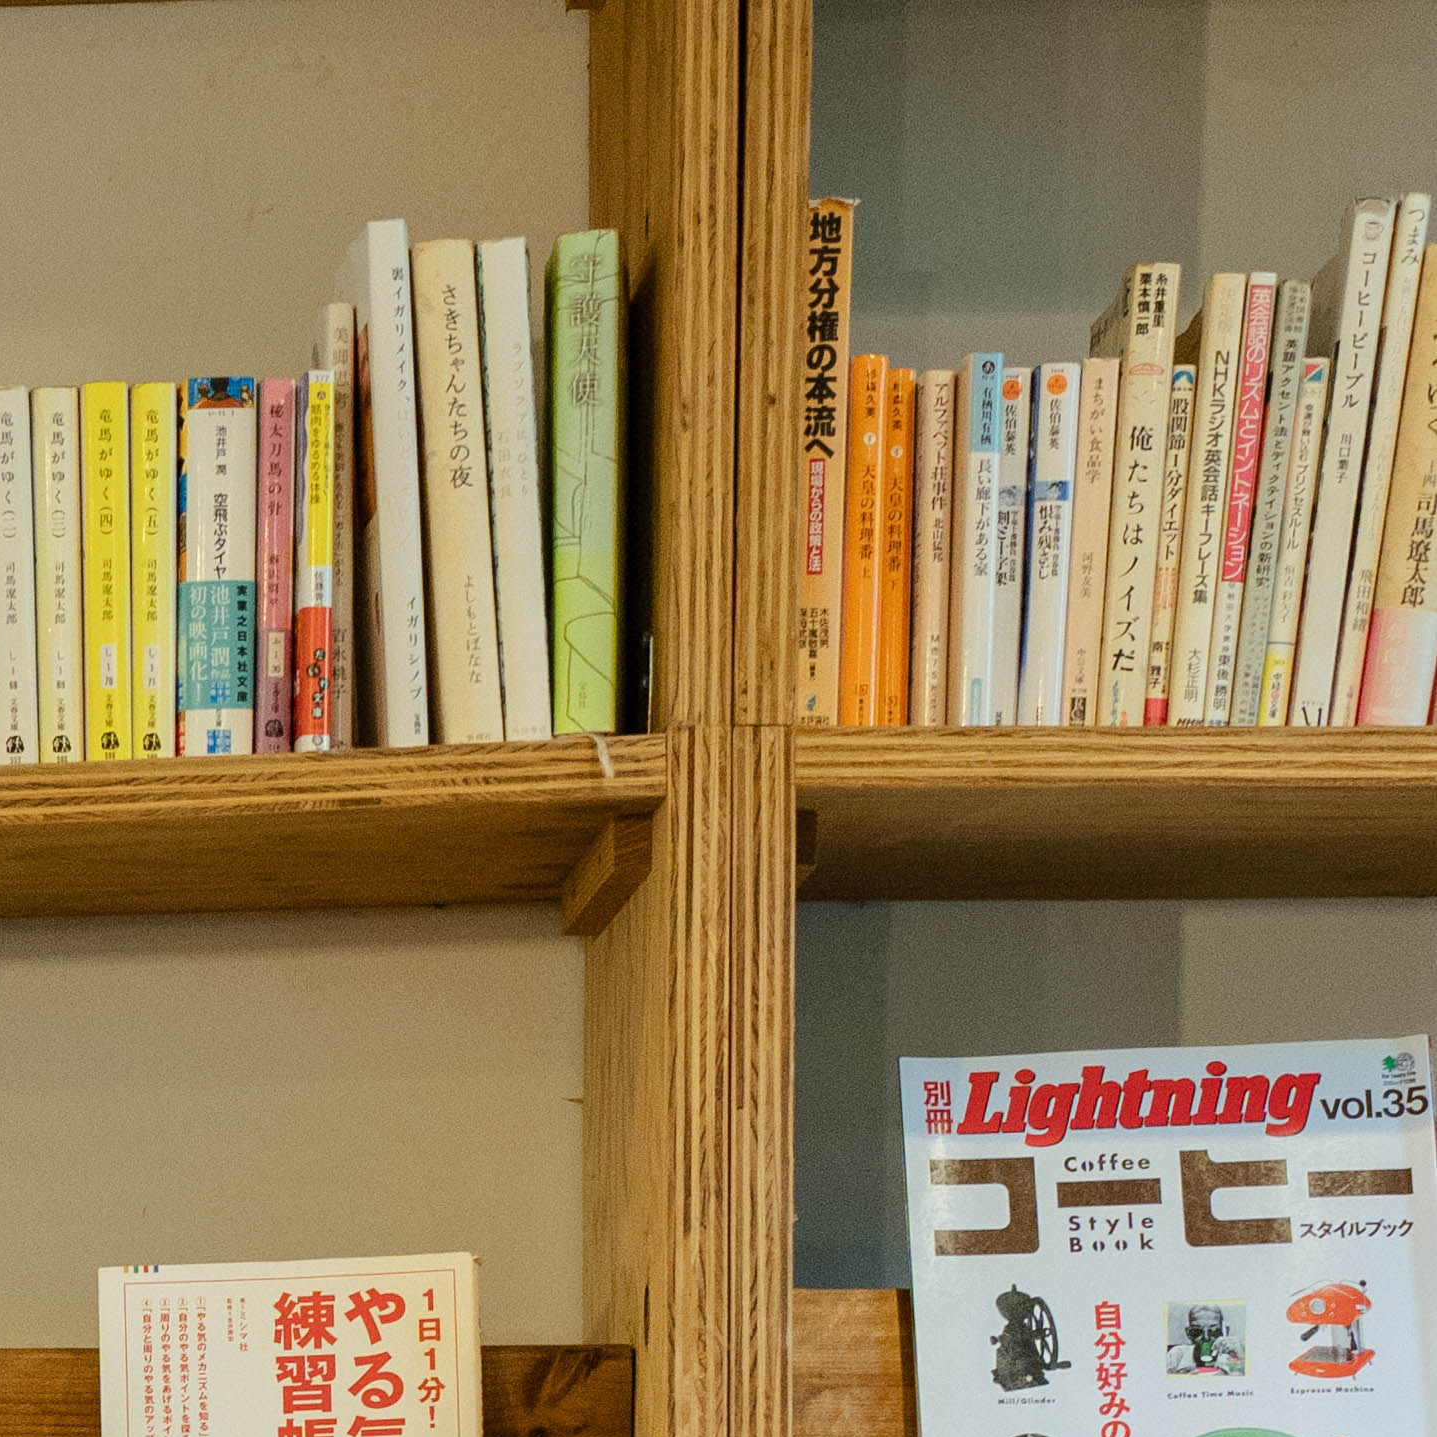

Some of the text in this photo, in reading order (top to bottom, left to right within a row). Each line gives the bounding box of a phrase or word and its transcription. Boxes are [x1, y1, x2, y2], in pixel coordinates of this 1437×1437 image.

[803, 212, 843, 459] 地方分権の本流へ
[440, 283, 475, 490] さきちゃんたちの夜
[99, 409, 114, 501] 竜馬がゆく
[1223, 287, 1273, 580] 英会話のリズムとイントネーション
[973, 459, 992, 577] 長い廊下がある家
[1111, 424, 1154, 673] 俺たちはノイズだ
[956, 1060, 1321, 1148] Lightning
[1320, 1085, 1429, 1122] vol.35
[1063, 1155, 1151, 1173] Coffee
[1068, 1214, 1155, 1233] Style
[1069, 1234, 1155, 1253] Book
[1299, 1219, 1414, 1239] スタイルブック
[1167, 1392, 1198, 1400] Coffee
[1201, 1391, 1224, 1399] Time
